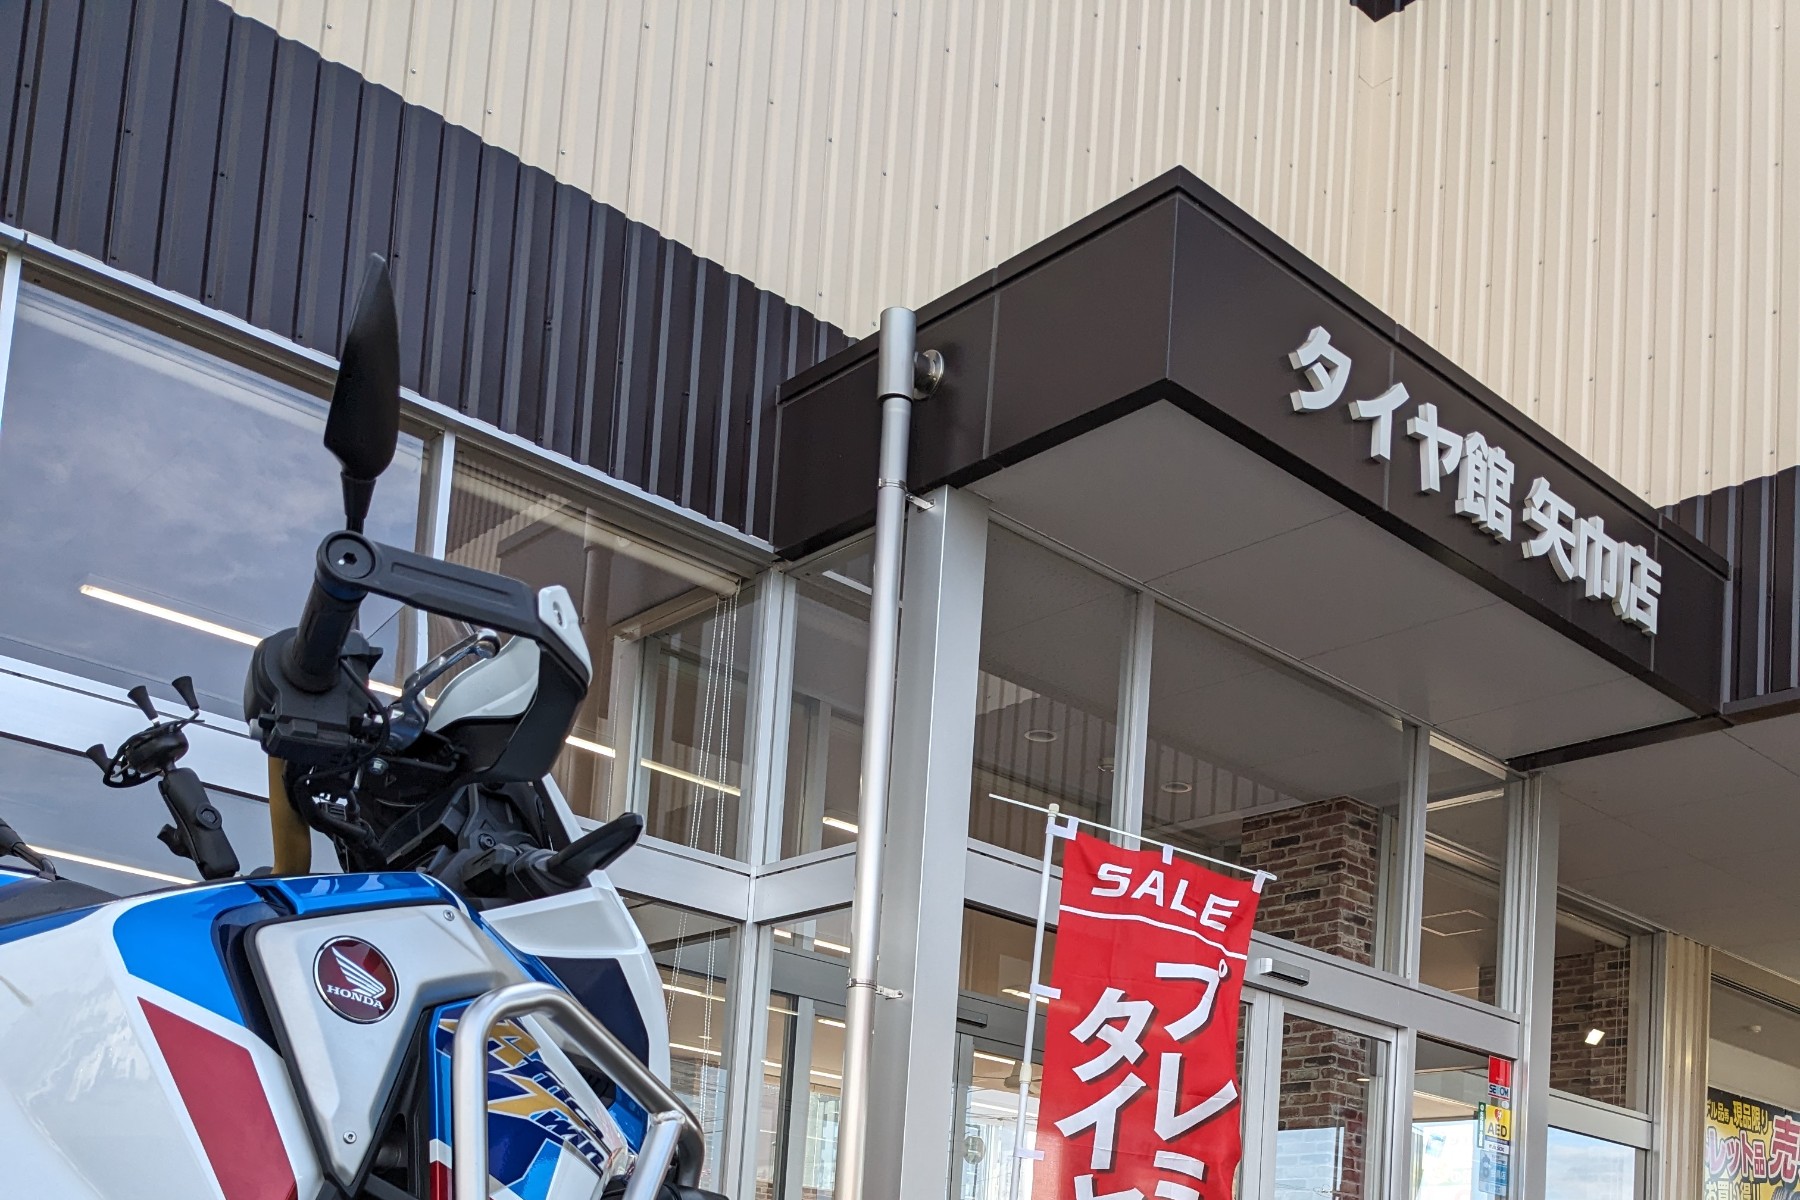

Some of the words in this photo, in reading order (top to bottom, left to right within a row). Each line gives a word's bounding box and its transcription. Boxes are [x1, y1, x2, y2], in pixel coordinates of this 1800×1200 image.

[1288, 326, 1514, 541] タイヤ館
[1522, 477, 1661, 634] 矢巾店
[1091, 863, 1239, 932] SALE
[327, 984, 385, 1010] HONDA
[1487, 1122, 1508, 1138] AED
[1705, 1126, 1767, 1179] レット品
